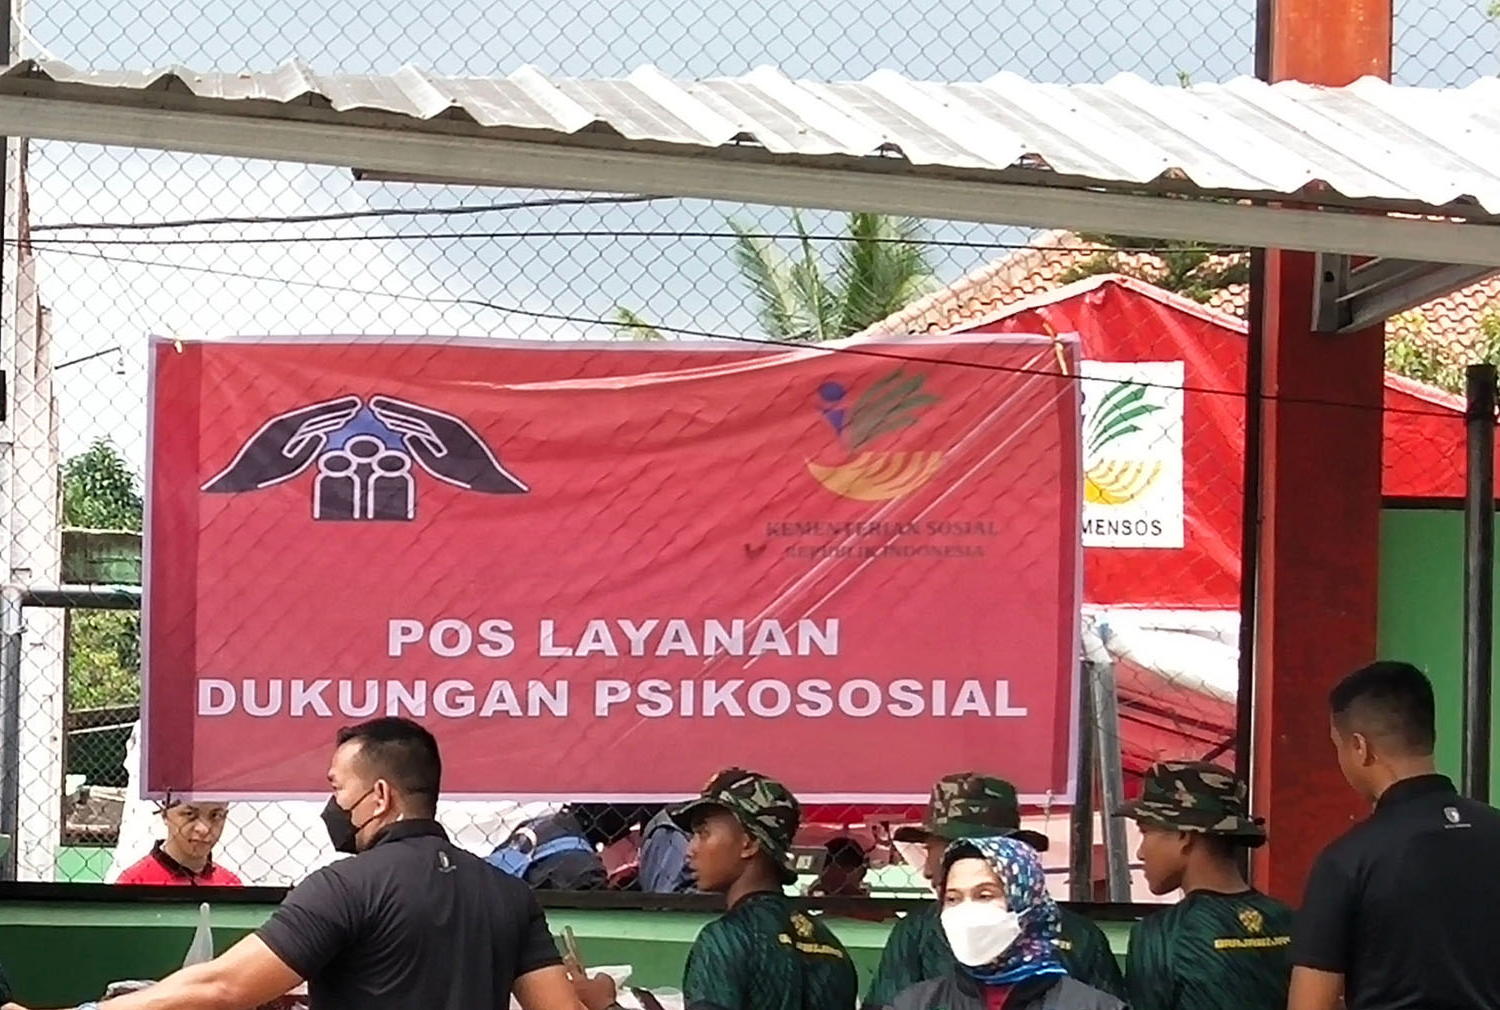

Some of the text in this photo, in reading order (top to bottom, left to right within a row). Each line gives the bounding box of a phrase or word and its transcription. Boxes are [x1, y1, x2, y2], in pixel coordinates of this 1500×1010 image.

[927, 520, 998, 537] SOSIAL
[388, 618, 840, 658] POS LAYANAN
[198, 679, 1028, 718] DUKUNGAN PSIKOSOSIAL
